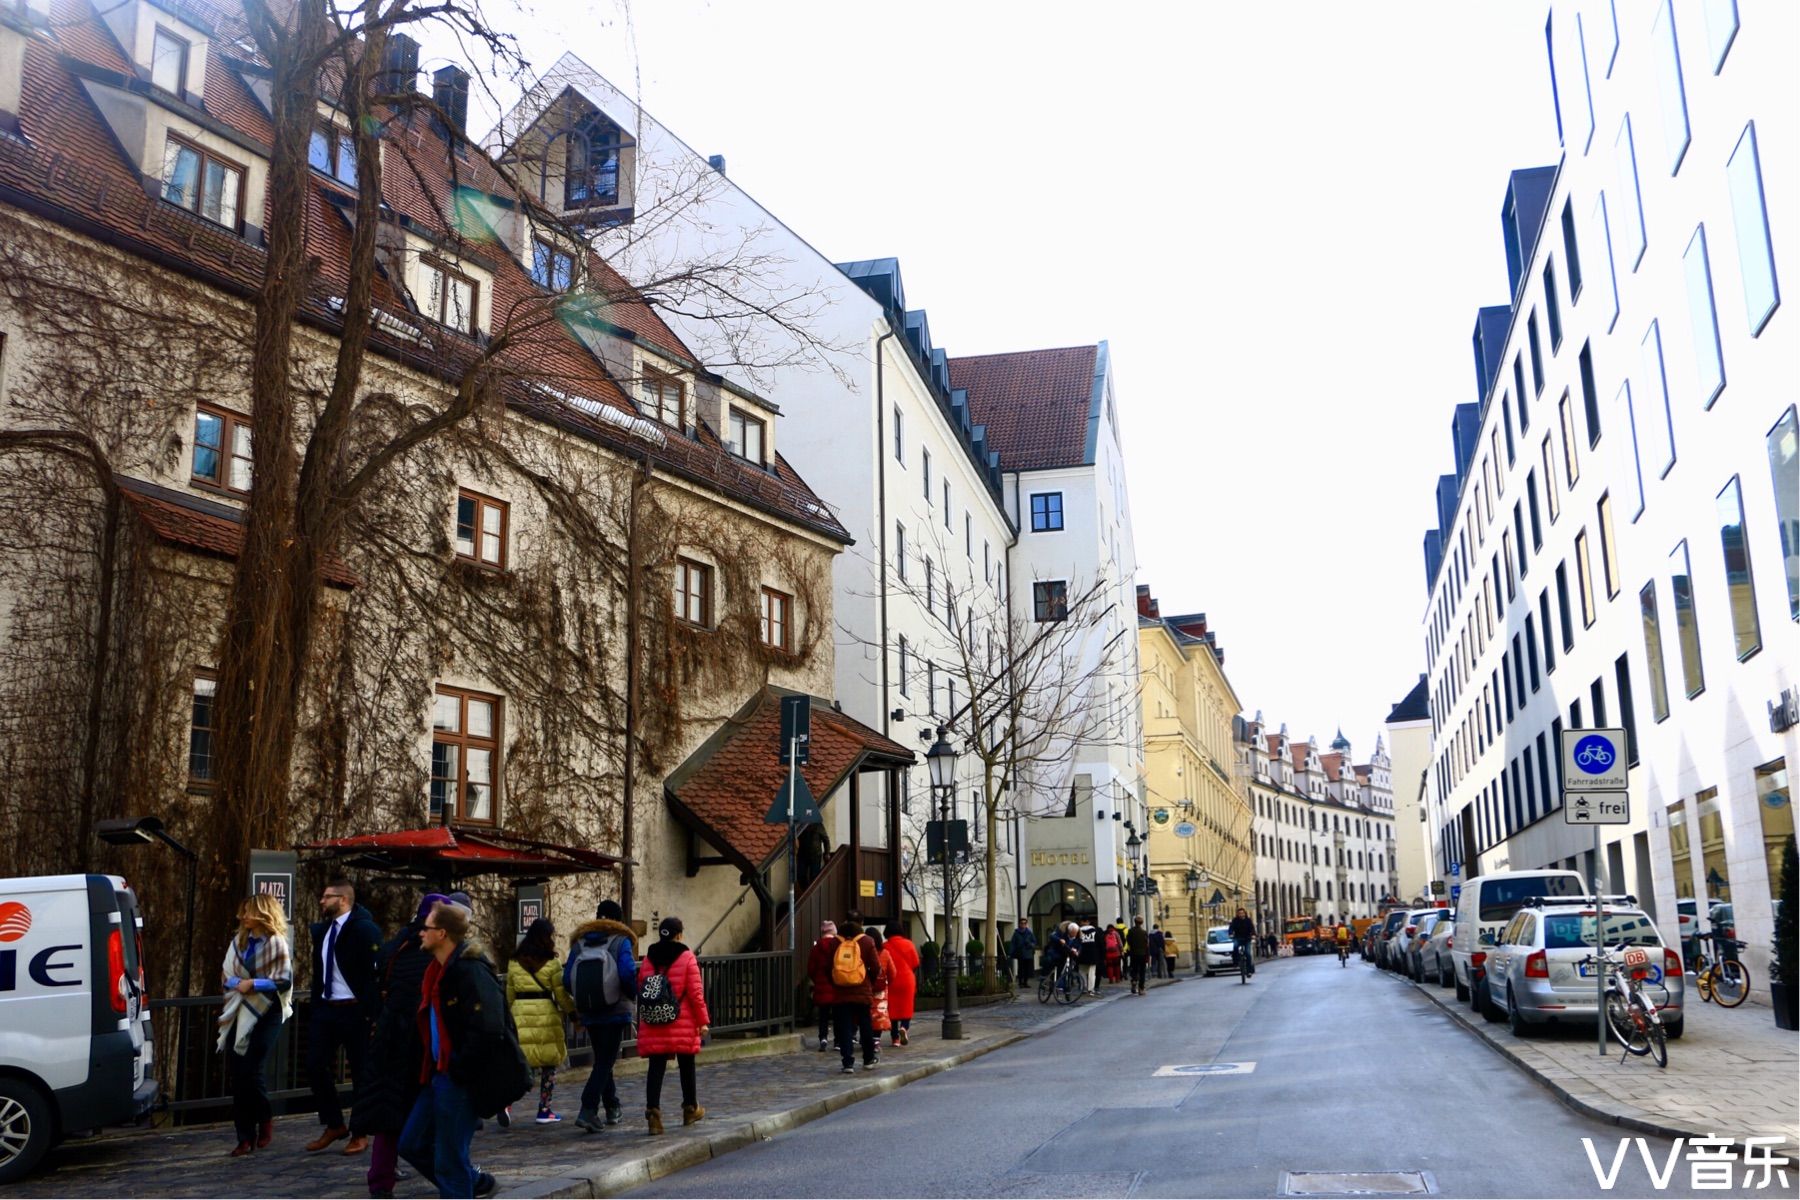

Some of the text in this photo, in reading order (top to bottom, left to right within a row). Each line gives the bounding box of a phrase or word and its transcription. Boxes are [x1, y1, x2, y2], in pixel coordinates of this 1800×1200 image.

[1568, 777, 1624, 786] Fahrradstraße
[1599, 802, 1626, 815] frei
[260, 881, 286, 897] PLATZL
[1627, 952, 1644, 964] DB
